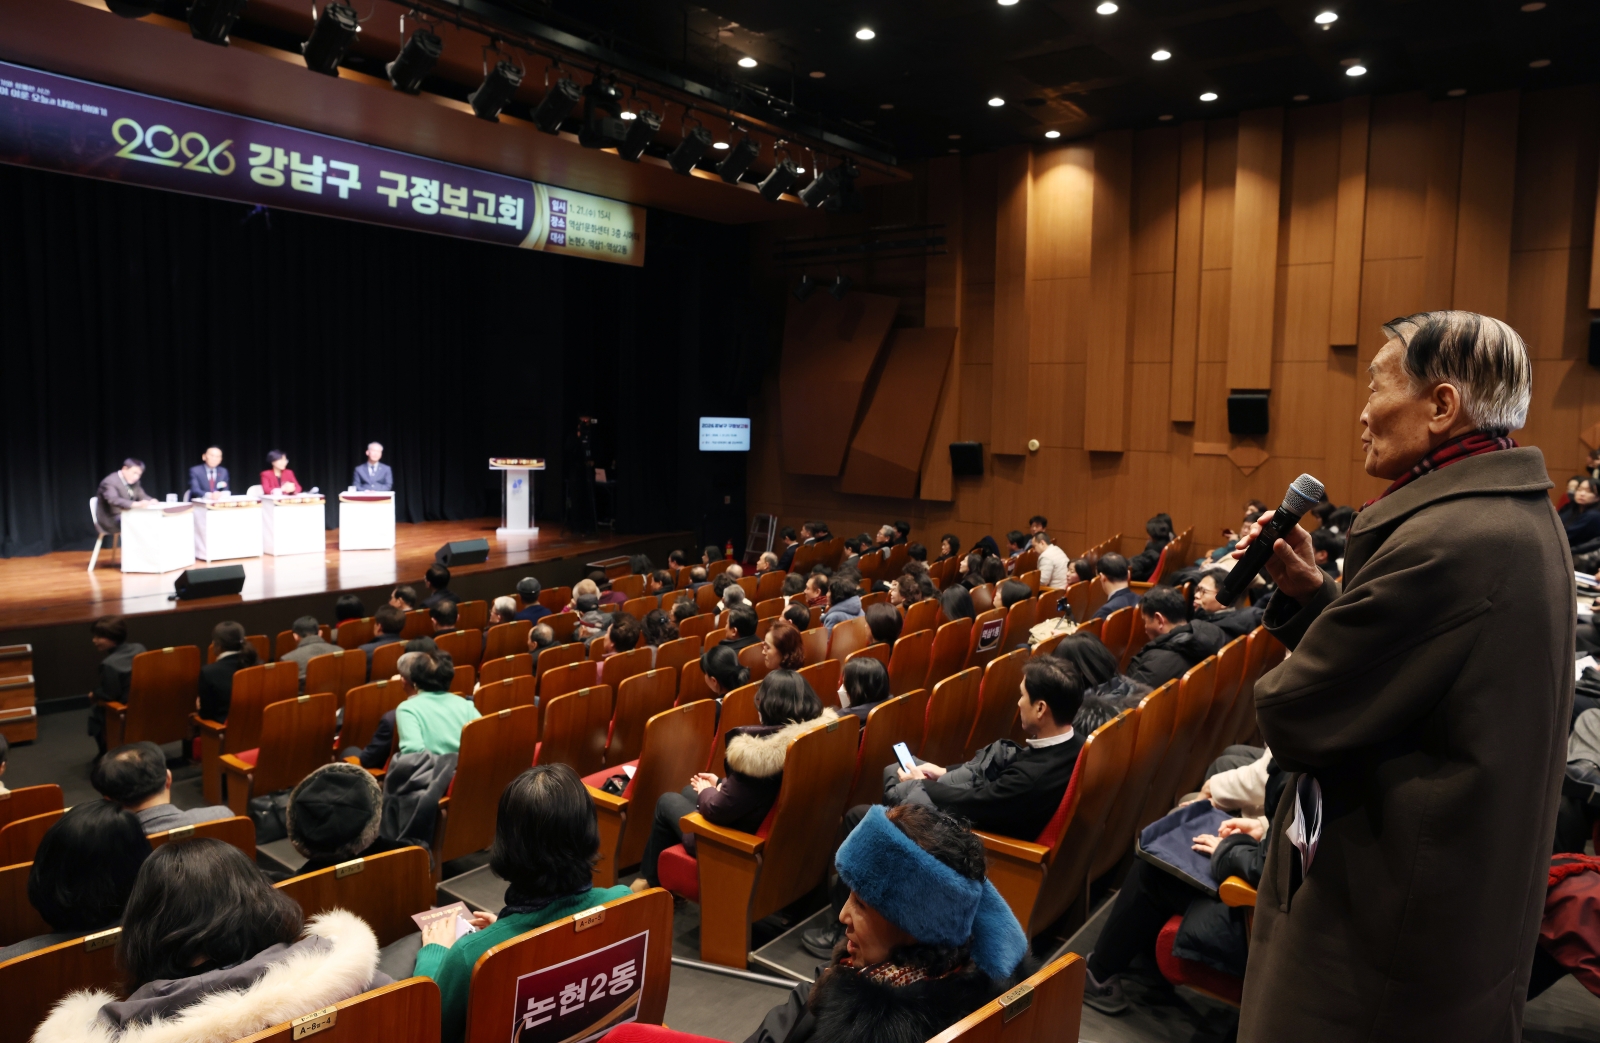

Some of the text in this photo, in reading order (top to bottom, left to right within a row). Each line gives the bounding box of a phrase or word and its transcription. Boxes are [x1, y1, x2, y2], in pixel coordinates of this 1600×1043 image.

[111, 117, 525, 231] 2026 강남구 구정보고회
[551, 199, 567, 213] 일시
[598, 210, 611, 221] 15시
[550, 215, 566, 228] 장소
[568, 219, 610, 236] 역삼1문화센터
[611, 228, 621, 239] 3층
[550, 231, 565, 245] 대상
[522, 958, 638, 1031] 논현2동
